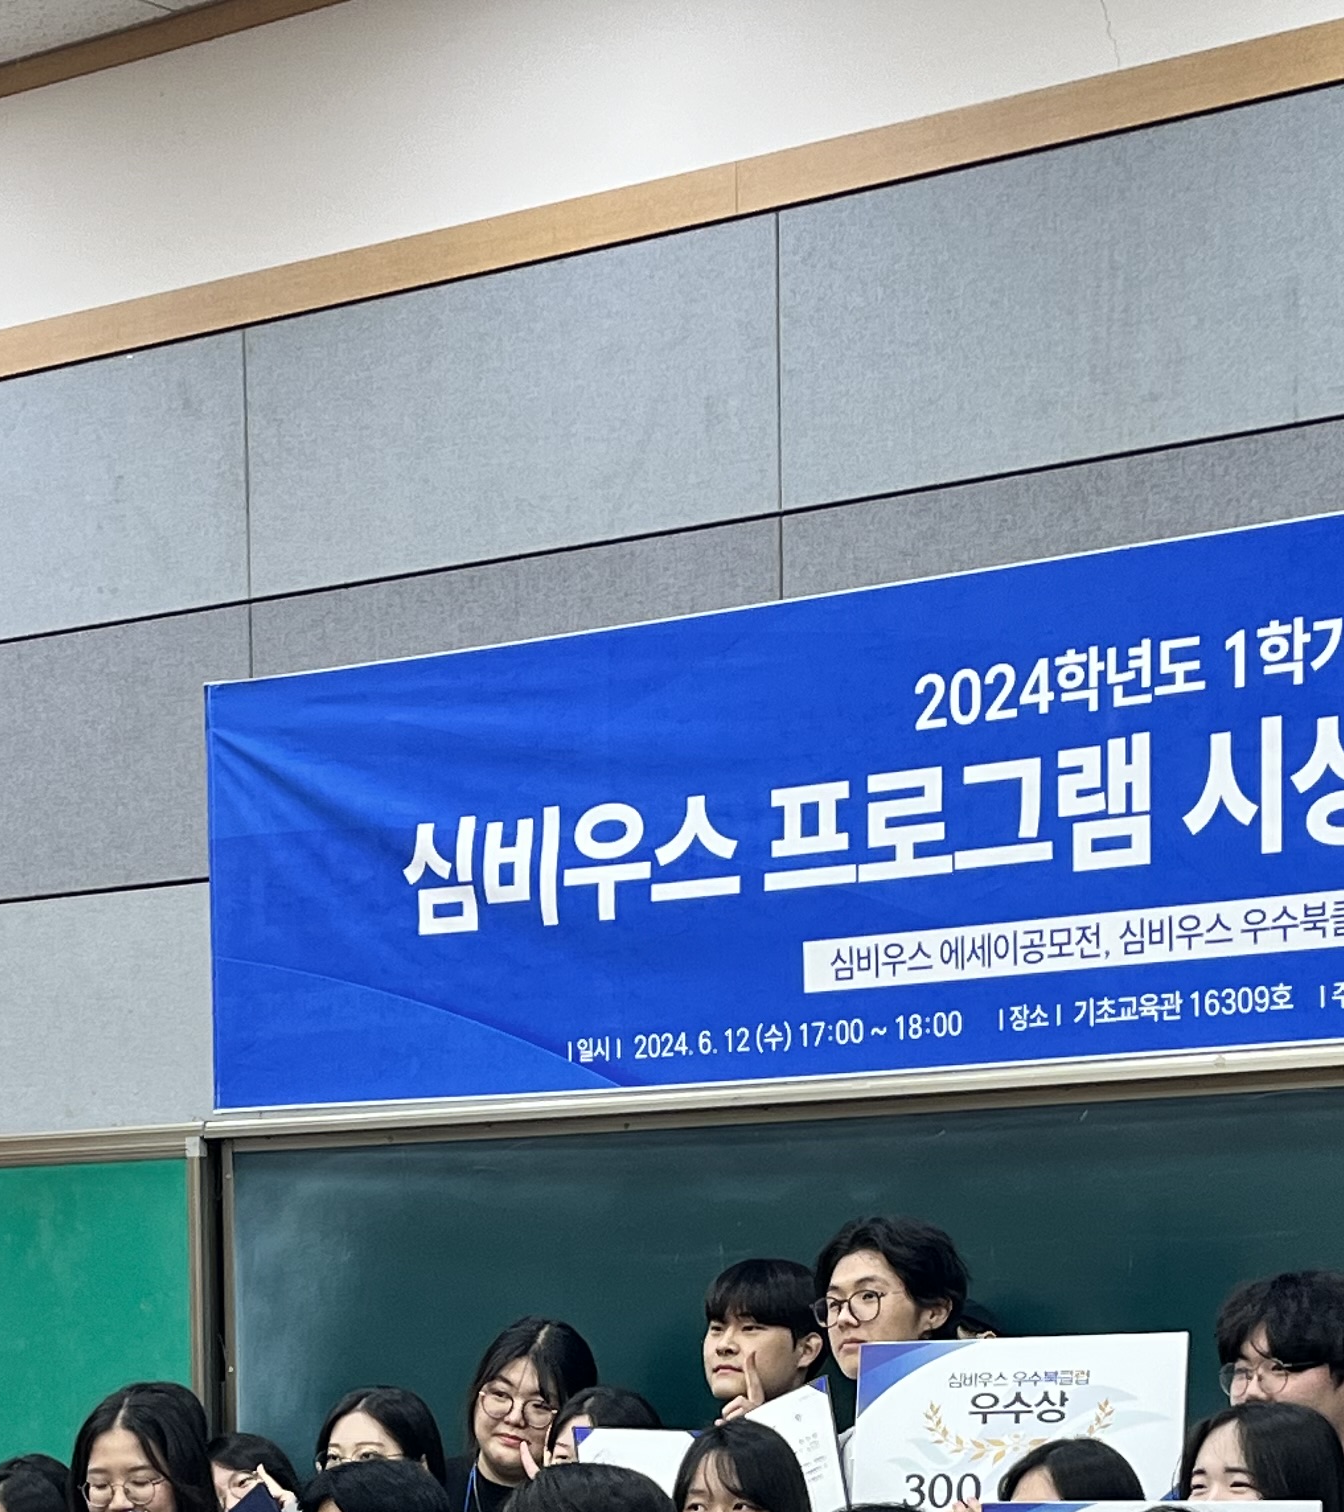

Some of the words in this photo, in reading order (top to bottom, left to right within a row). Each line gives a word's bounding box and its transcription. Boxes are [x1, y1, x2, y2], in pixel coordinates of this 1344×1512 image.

[915, 637, 1204, 731] 2024학년도
[402, 795, 741, 937] 심비우스
[763, 732, 1152, 893] 프로그램
[830, 939, 933, 982] 심비우스
[940, 922, 1111, 972] 에세이공모전,
[1118, 913, 1233, 957] 심비우스
[1008, 1004, 1050, 1032] 장소
[1073, 990, 1183, 1028] 기초교육관
[1190, 982, 1294, 1018] 16309호
[577, 1038, 611, 1063] 일시
[799, 1018, 864, 1048] 17:00
[895, 1010, 963, 1040] 18:00
[947, 1371, 1009, 1389] 심비우스
[968, 1390, 1070, 1425] 우수상
